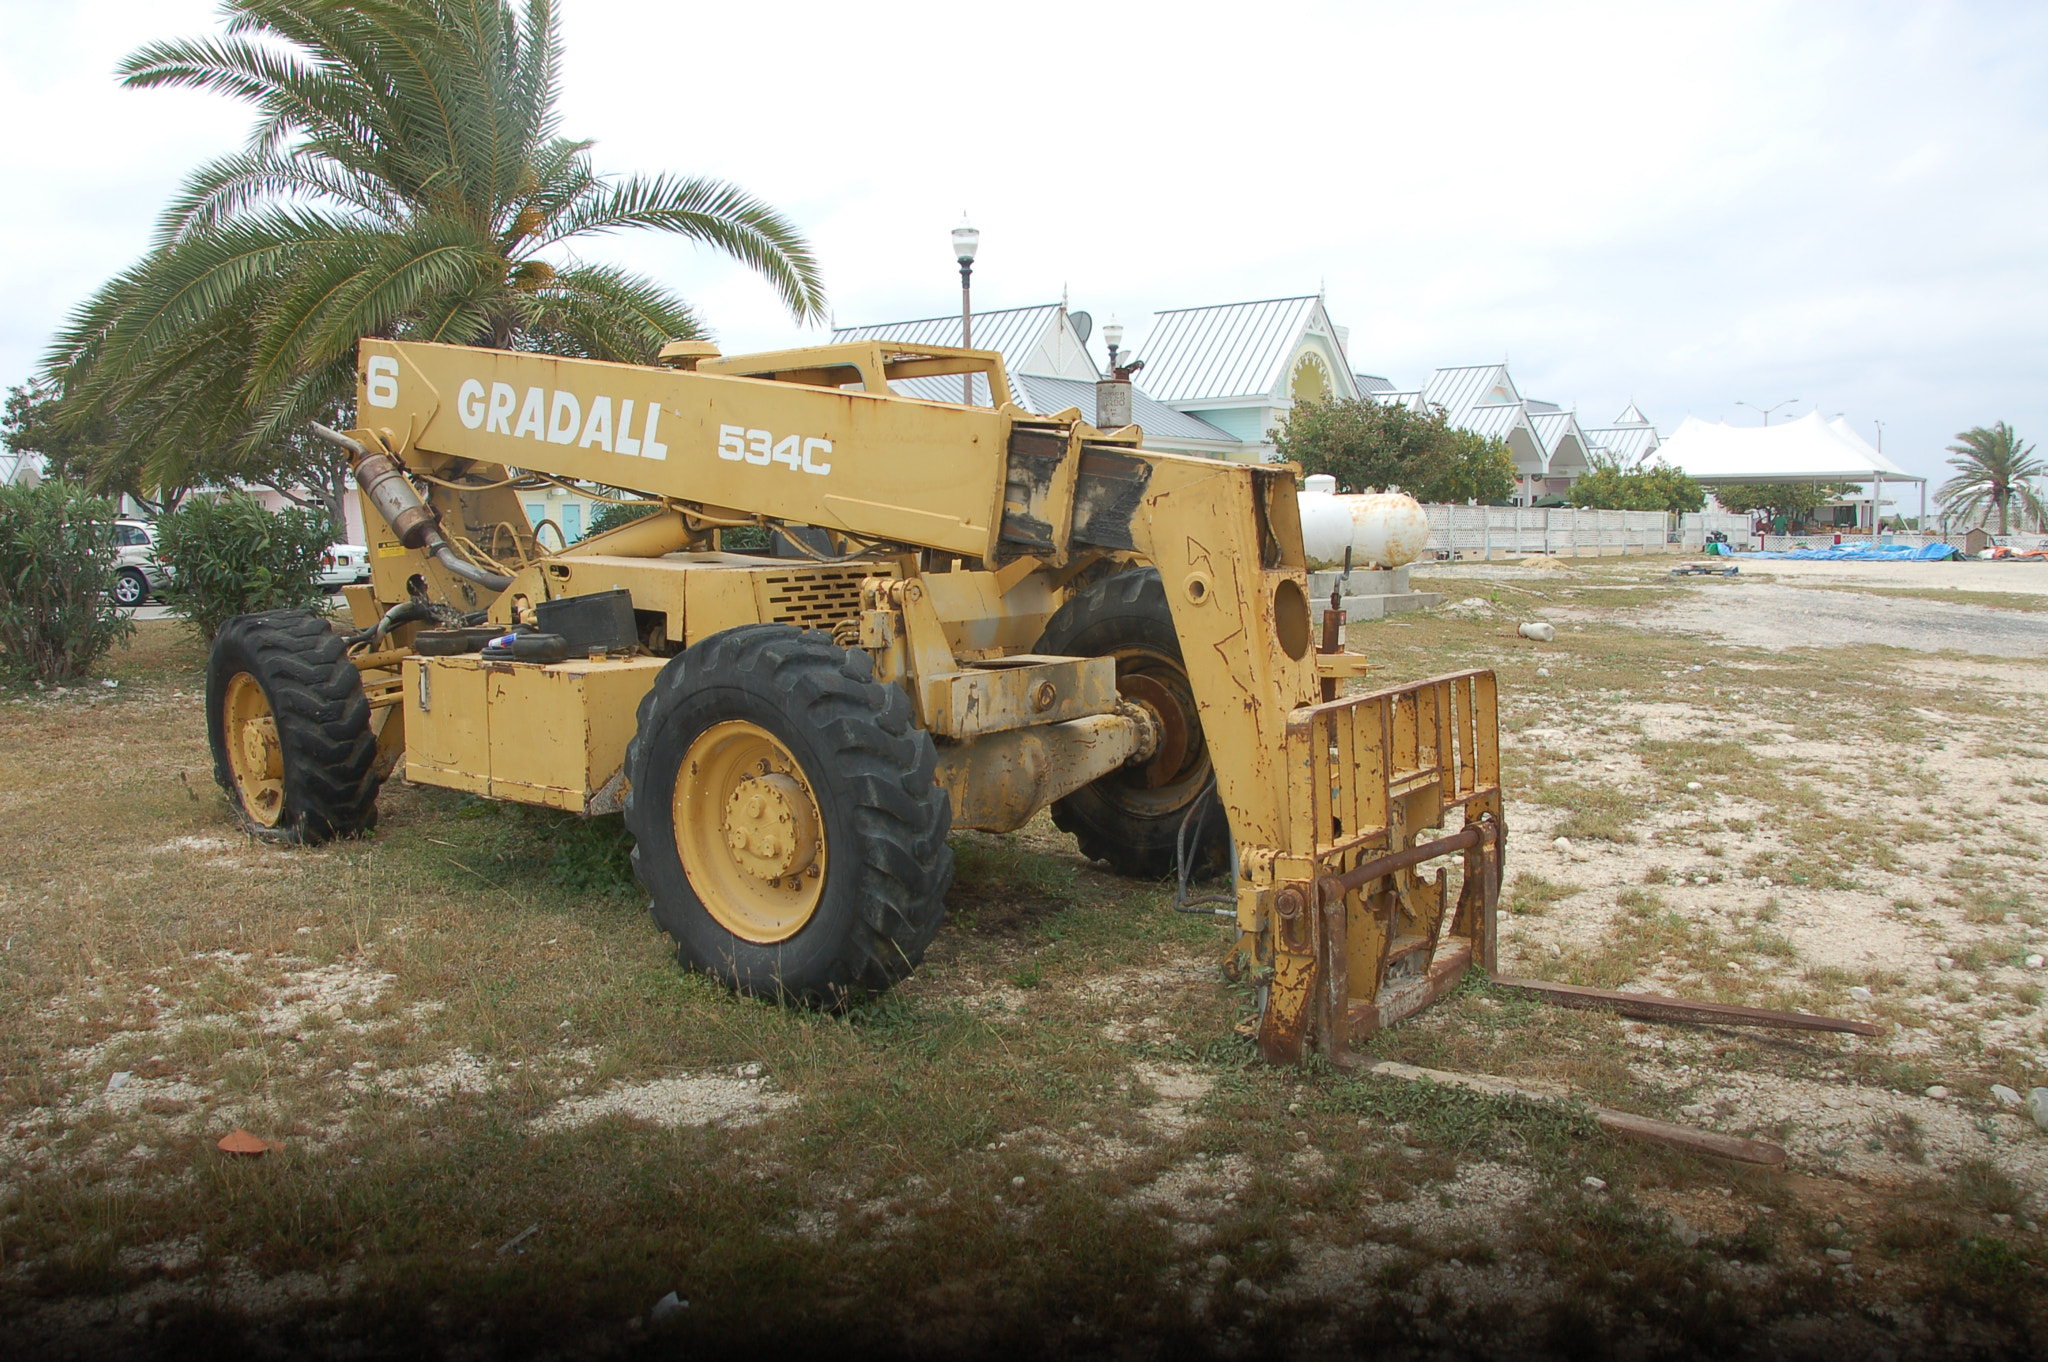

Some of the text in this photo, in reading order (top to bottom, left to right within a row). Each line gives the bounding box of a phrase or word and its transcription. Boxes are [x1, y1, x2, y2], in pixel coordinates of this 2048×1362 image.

[367, 355, 399, 409] 6
[457, 379, 668, 461] GRADALL
[717, 423, 834, 476] 534C
